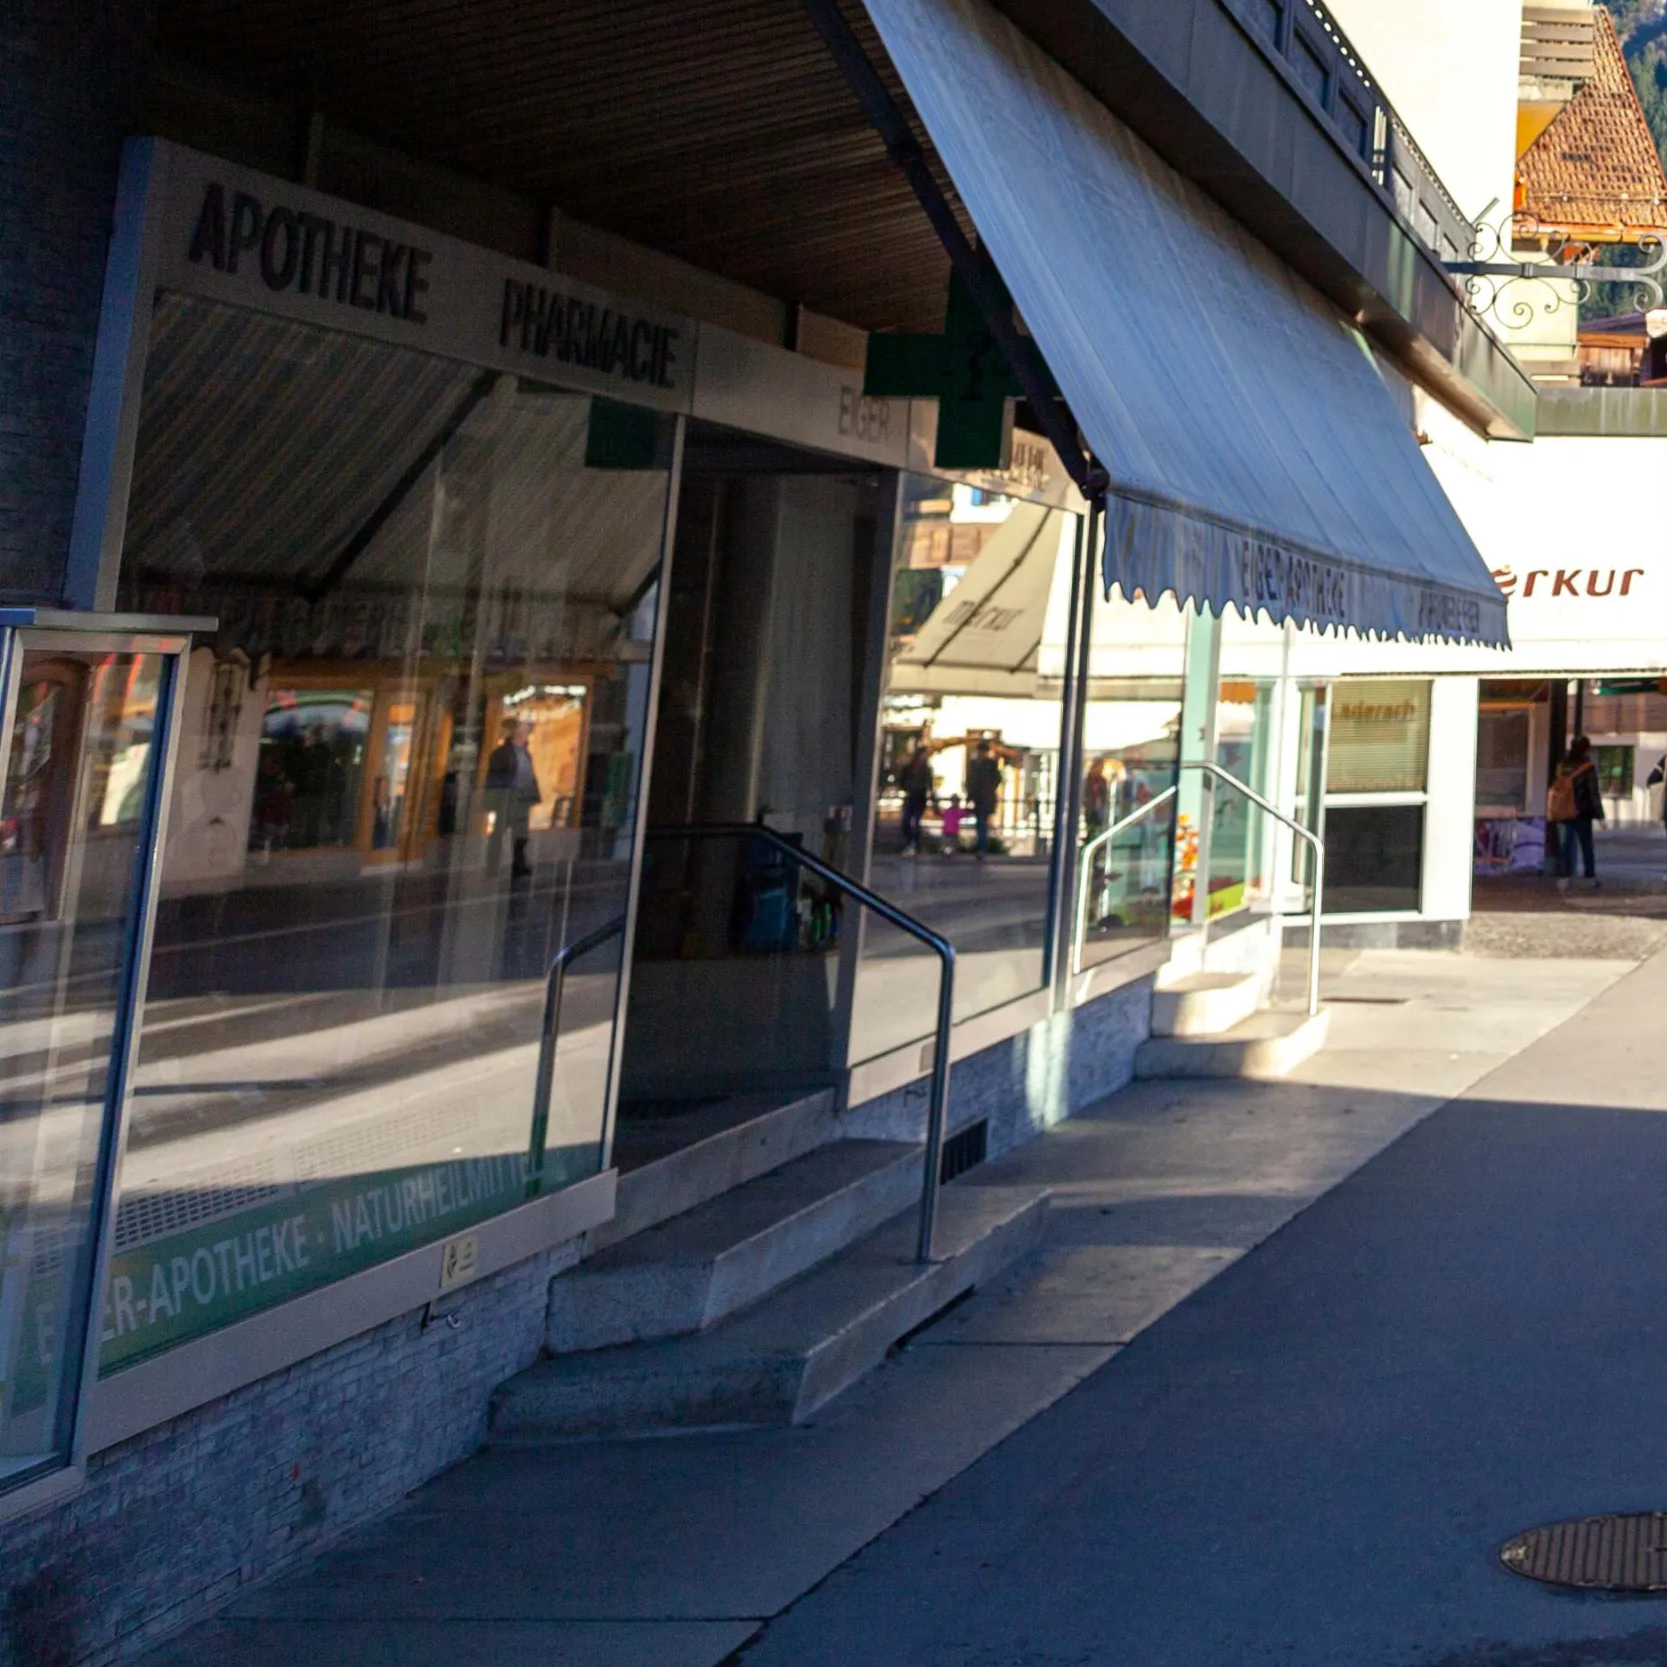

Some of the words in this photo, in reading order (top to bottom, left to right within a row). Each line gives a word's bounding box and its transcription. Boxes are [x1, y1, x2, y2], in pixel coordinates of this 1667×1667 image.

[188, 183, 433, 324] APOTHEKE
[500, 278, 680, 389] PHARMACIE
[1491, 564, 1645, 598] erkur
